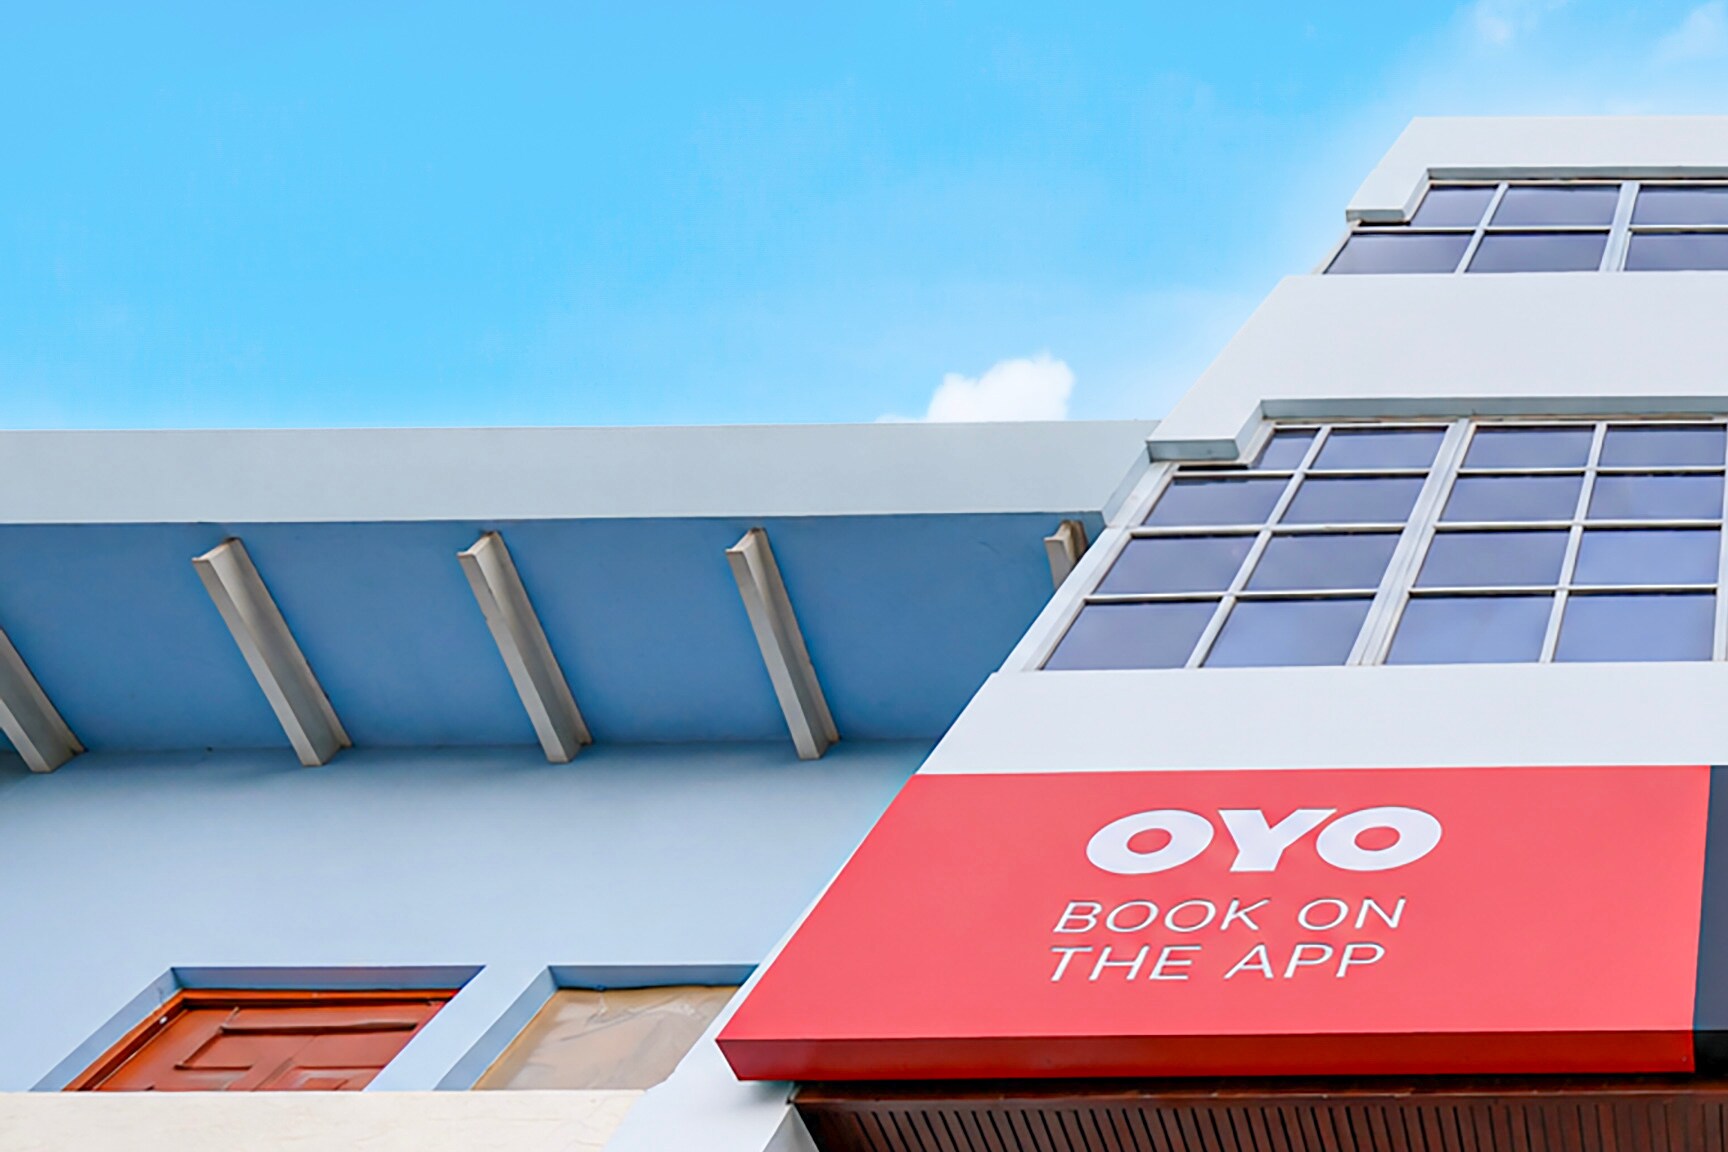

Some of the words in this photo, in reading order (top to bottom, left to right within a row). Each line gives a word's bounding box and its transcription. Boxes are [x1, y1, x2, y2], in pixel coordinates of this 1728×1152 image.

[1086, 806, 1443, 875] OYO
[1053, 898, 1270, 934] BOOK
[1297, 897, 1406, 931] ON
[1049, 944, 1202, 983] THE
[1223, 943, 1386, 979] APP
